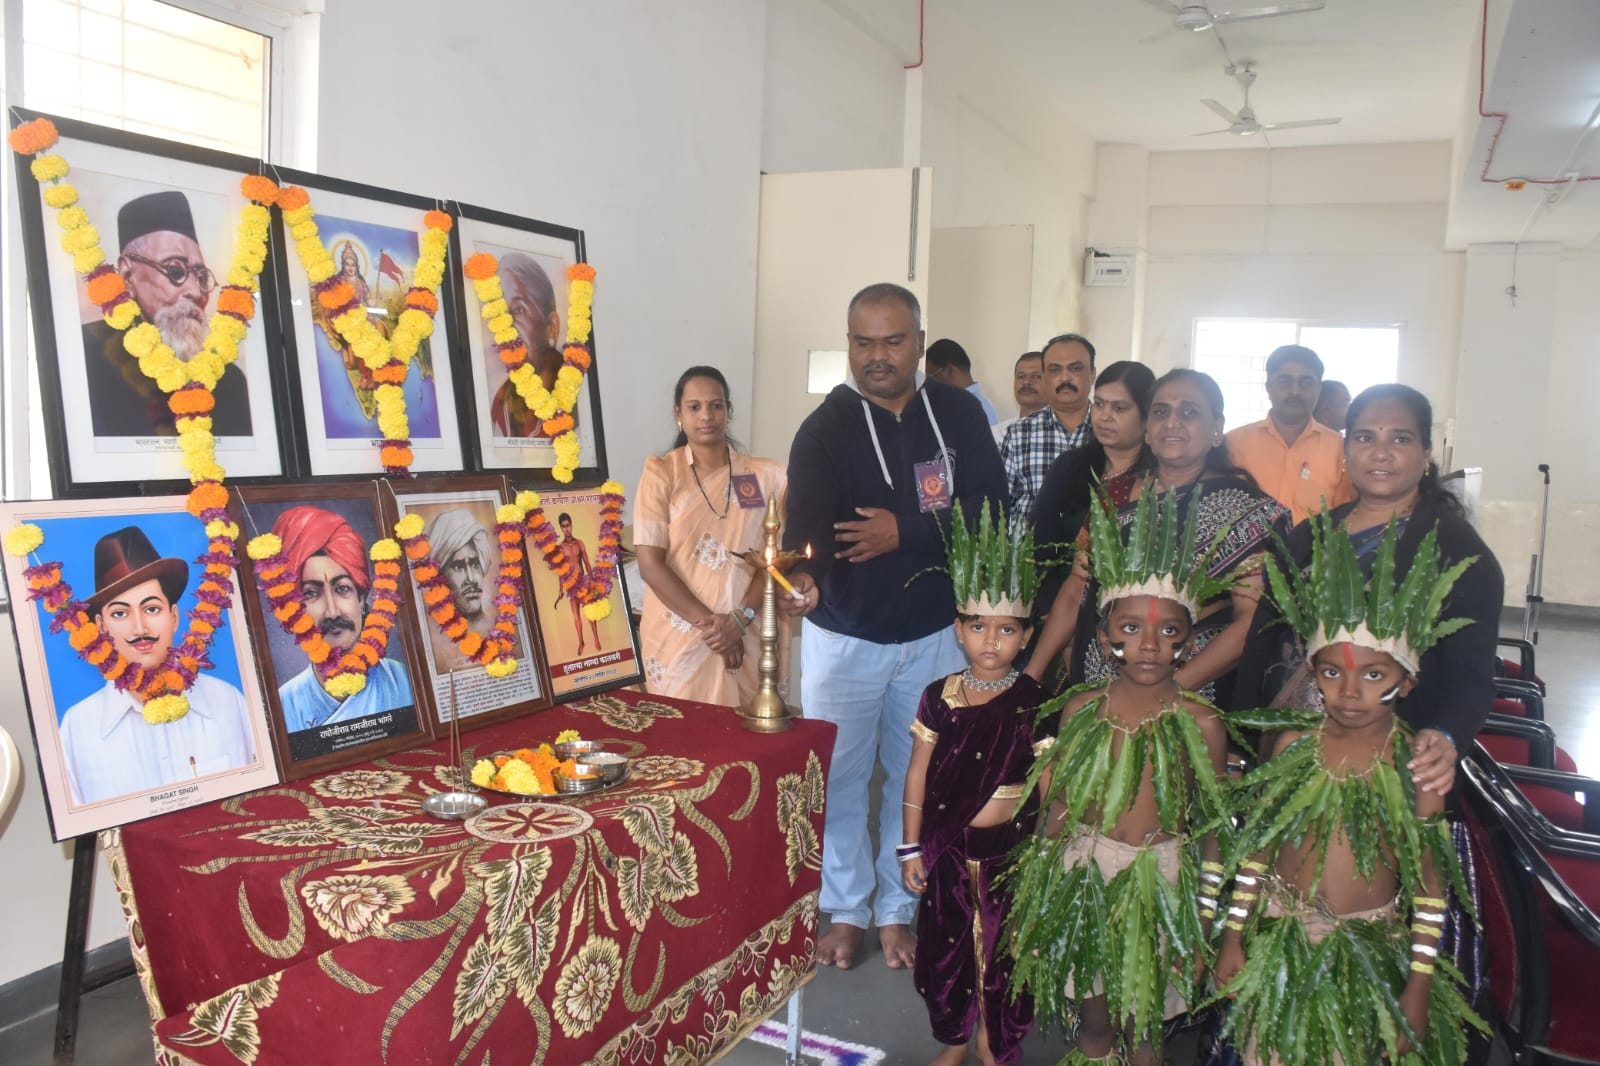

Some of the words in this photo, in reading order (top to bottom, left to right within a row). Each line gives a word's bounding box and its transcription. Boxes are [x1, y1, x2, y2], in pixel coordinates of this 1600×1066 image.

[350, 718, 377, 731] रामजीराव
[150, 790, 177, 802] BHAGAT
[179, 784, 199, 796] SINGH
